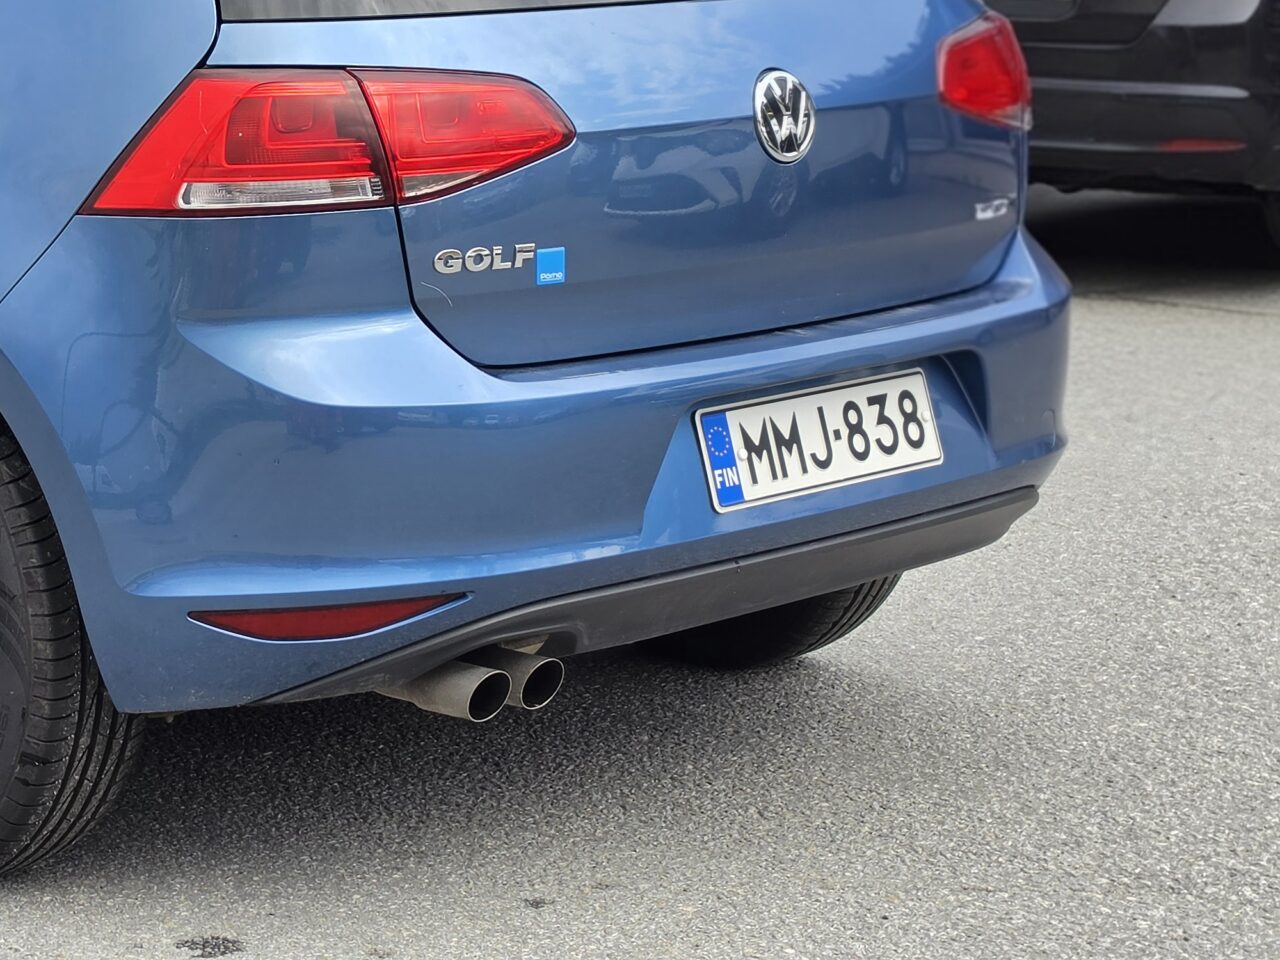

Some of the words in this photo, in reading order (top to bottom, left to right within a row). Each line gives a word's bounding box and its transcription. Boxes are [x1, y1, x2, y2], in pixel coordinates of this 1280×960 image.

[434, 243, 535, 274] GOLF
[739, 389, 925, 485] MMJ-838
[714, 466, 739, 489] FIN
